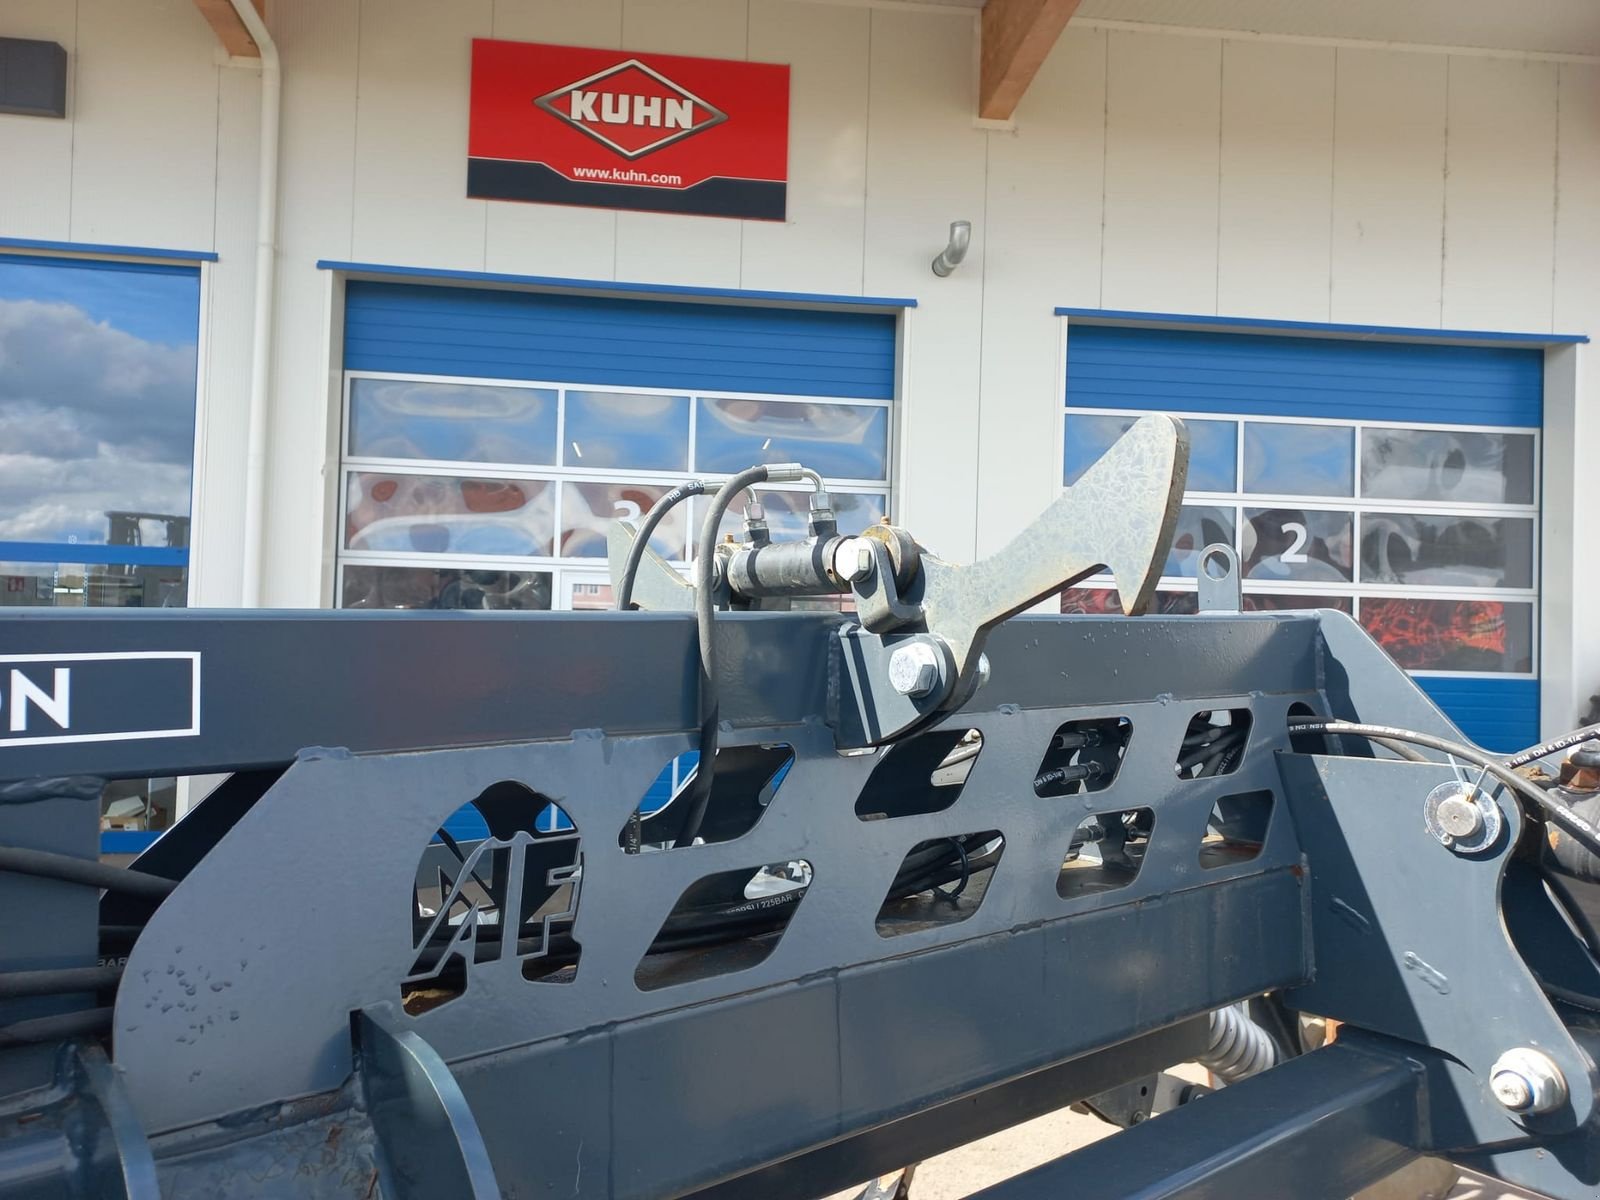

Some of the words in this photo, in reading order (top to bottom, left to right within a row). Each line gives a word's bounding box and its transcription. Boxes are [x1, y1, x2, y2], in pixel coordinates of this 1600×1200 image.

[569, 90, 694, 129] KUHN
[573, 167, 682, 185] www.kuhn.com
[1280, 523, 1308, 564] 2
[0, 667, 70, 731] N
